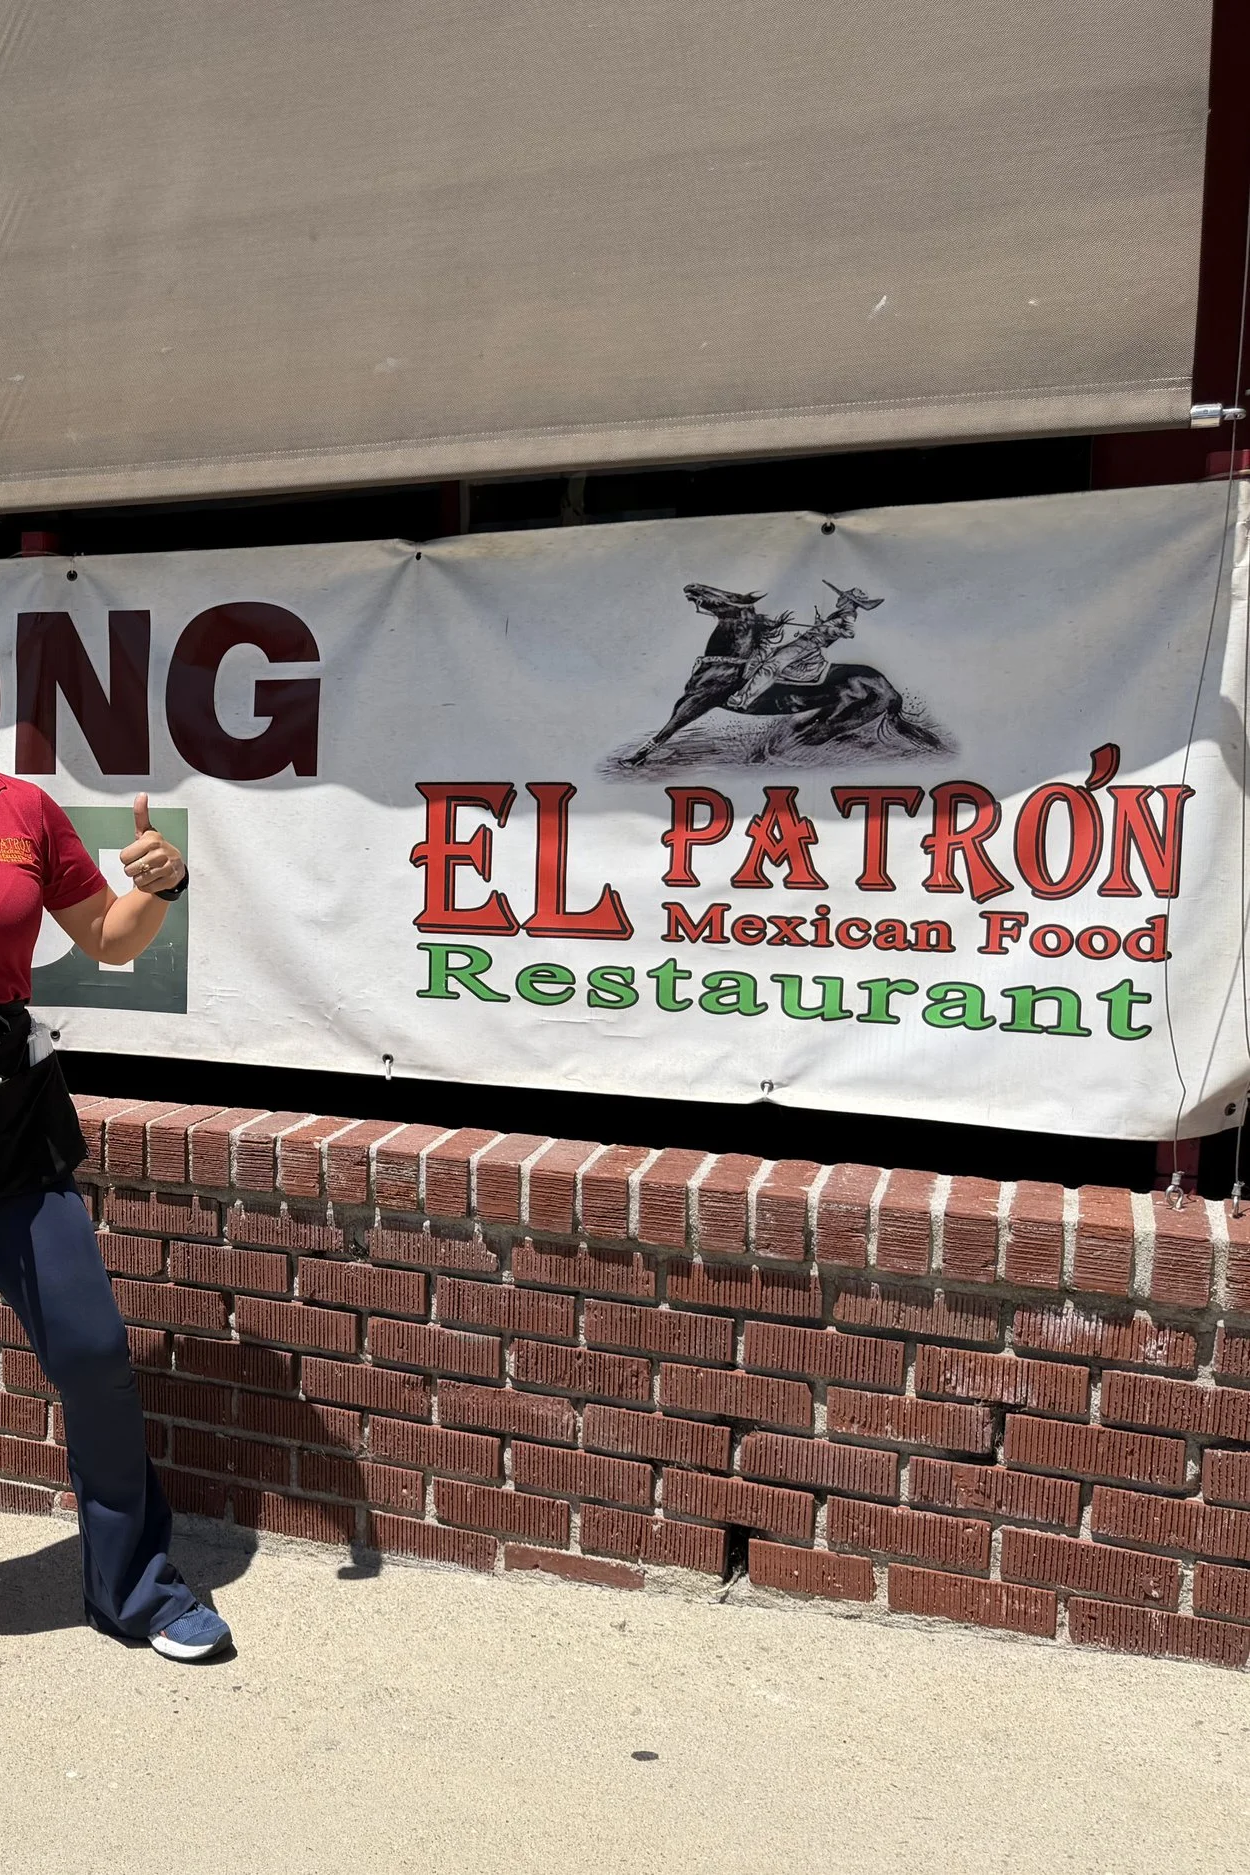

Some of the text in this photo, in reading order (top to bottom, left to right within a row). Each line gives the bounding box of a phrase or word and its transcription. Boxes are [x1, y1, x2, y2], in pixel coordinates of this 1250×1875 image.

[410, 743, 1194, 940] EL PATRÓN
[661, 902, 1172, 962] Mexican Food
[417, 943, 1153, 1041] Restaurant
